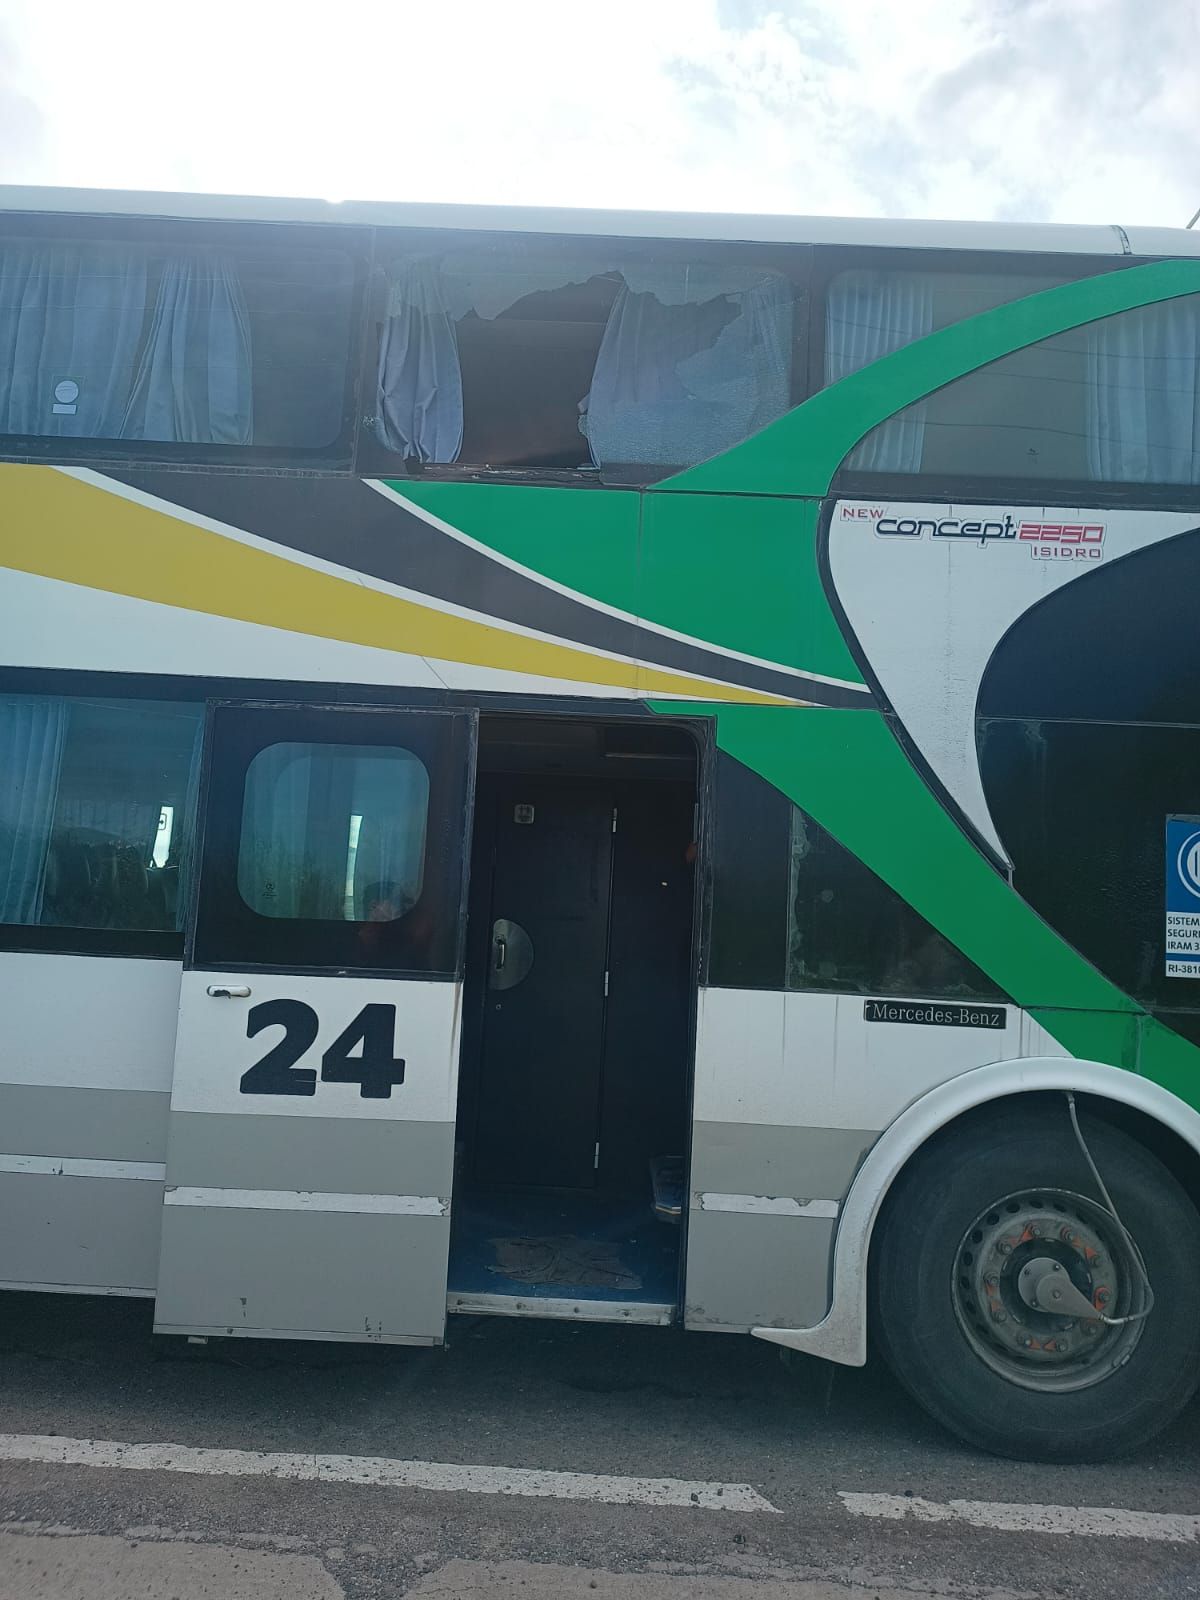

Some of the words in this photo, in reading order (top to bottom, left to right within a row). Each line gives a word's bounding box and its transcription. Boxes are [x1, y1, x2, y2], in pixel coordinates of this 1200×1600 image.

[843, 507, 885, 519] NEW
[875, 515, 1018, 544] concept
[1018, 523, 1104, 544] 2250
[1033, 546, 1101, 558] ISIDRO
[1167, 916, 1200, 926] SISTEM
[1167, 941, 1192, 951] IRAM
[872, 1003, 1000, 1026] Mercedes-Benz
[239, 998, 406, 1099] 24
